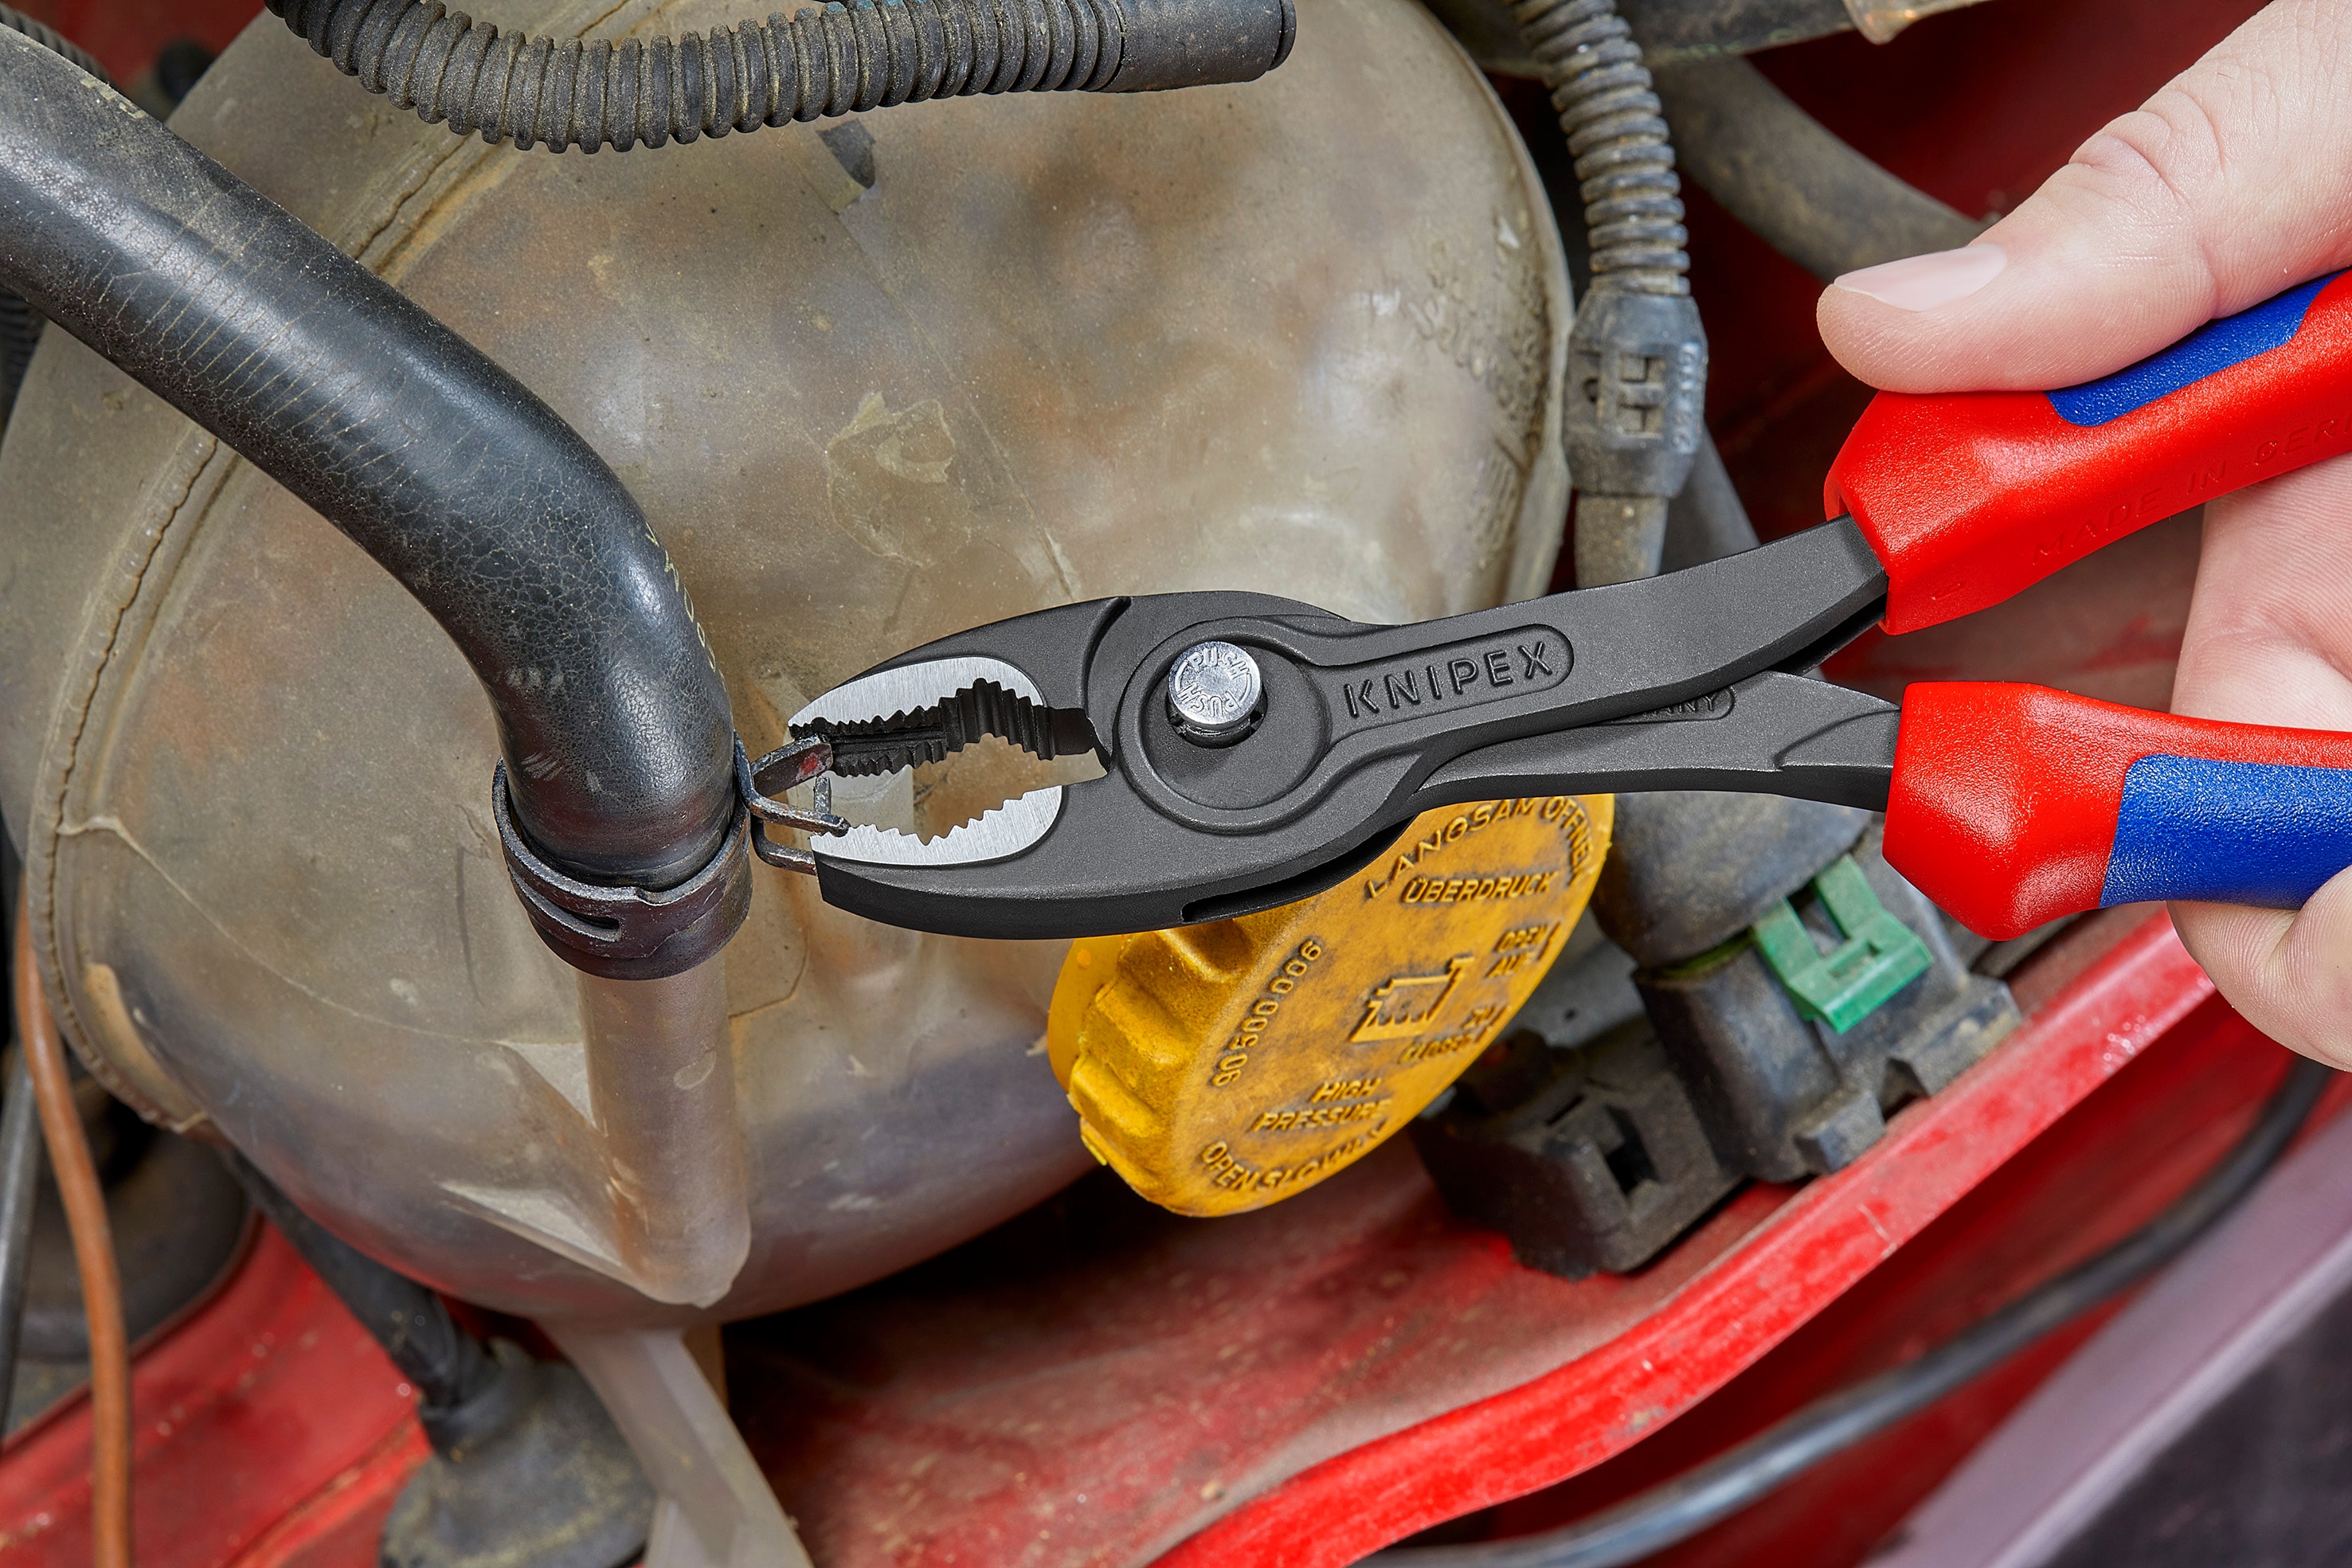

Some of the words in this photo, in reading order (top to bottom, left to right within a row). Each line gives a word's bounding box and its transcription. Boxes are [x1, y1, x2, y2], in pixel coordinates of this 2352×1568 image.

[2032, 487, 2162, 566] MADE
[2186, 460, 2228, 495] IN
[1187, 646, 1250, 681] PUSH
[1344, 641, 1553, 718] KNIPEX
[1177, 681, 1241, 718] PUSH
[1366, 799, 1536, 899] LANGSAM
[1401, 872, 1560, 904] ÜBERDRUCK
[1310, 1077, 1383, 1103] HIGH
[1252, 1098, 1393, 1132] PRESSURE
[1201, 1140, 1262, 1191] OPEN
